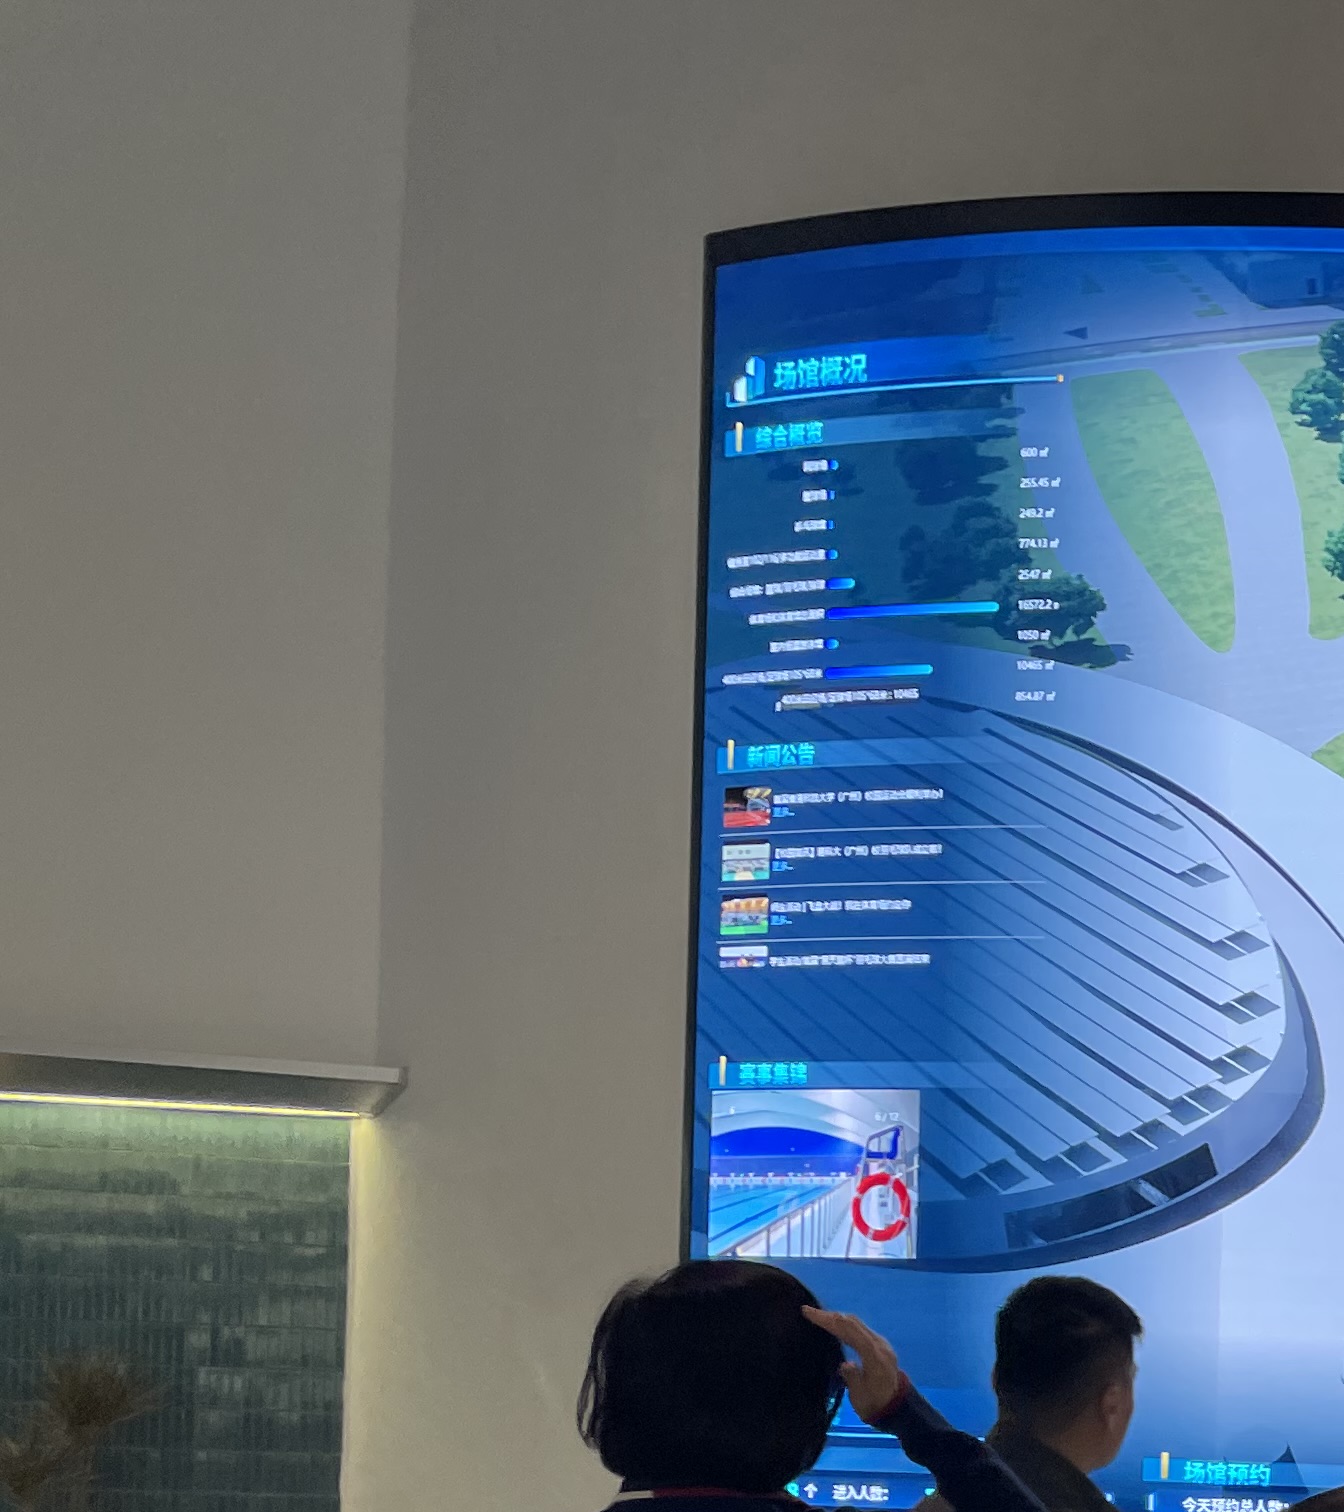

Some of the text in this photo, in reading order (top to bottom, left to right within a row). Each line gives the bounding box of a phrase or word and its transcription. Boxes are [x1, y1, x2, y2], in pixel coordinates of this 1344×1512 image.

[773, 353, 868, 390] 场馆概况
[747, 742, 816, 768] 新闻公告
[1183, 1460, 1272, 1487] 场馆预约
